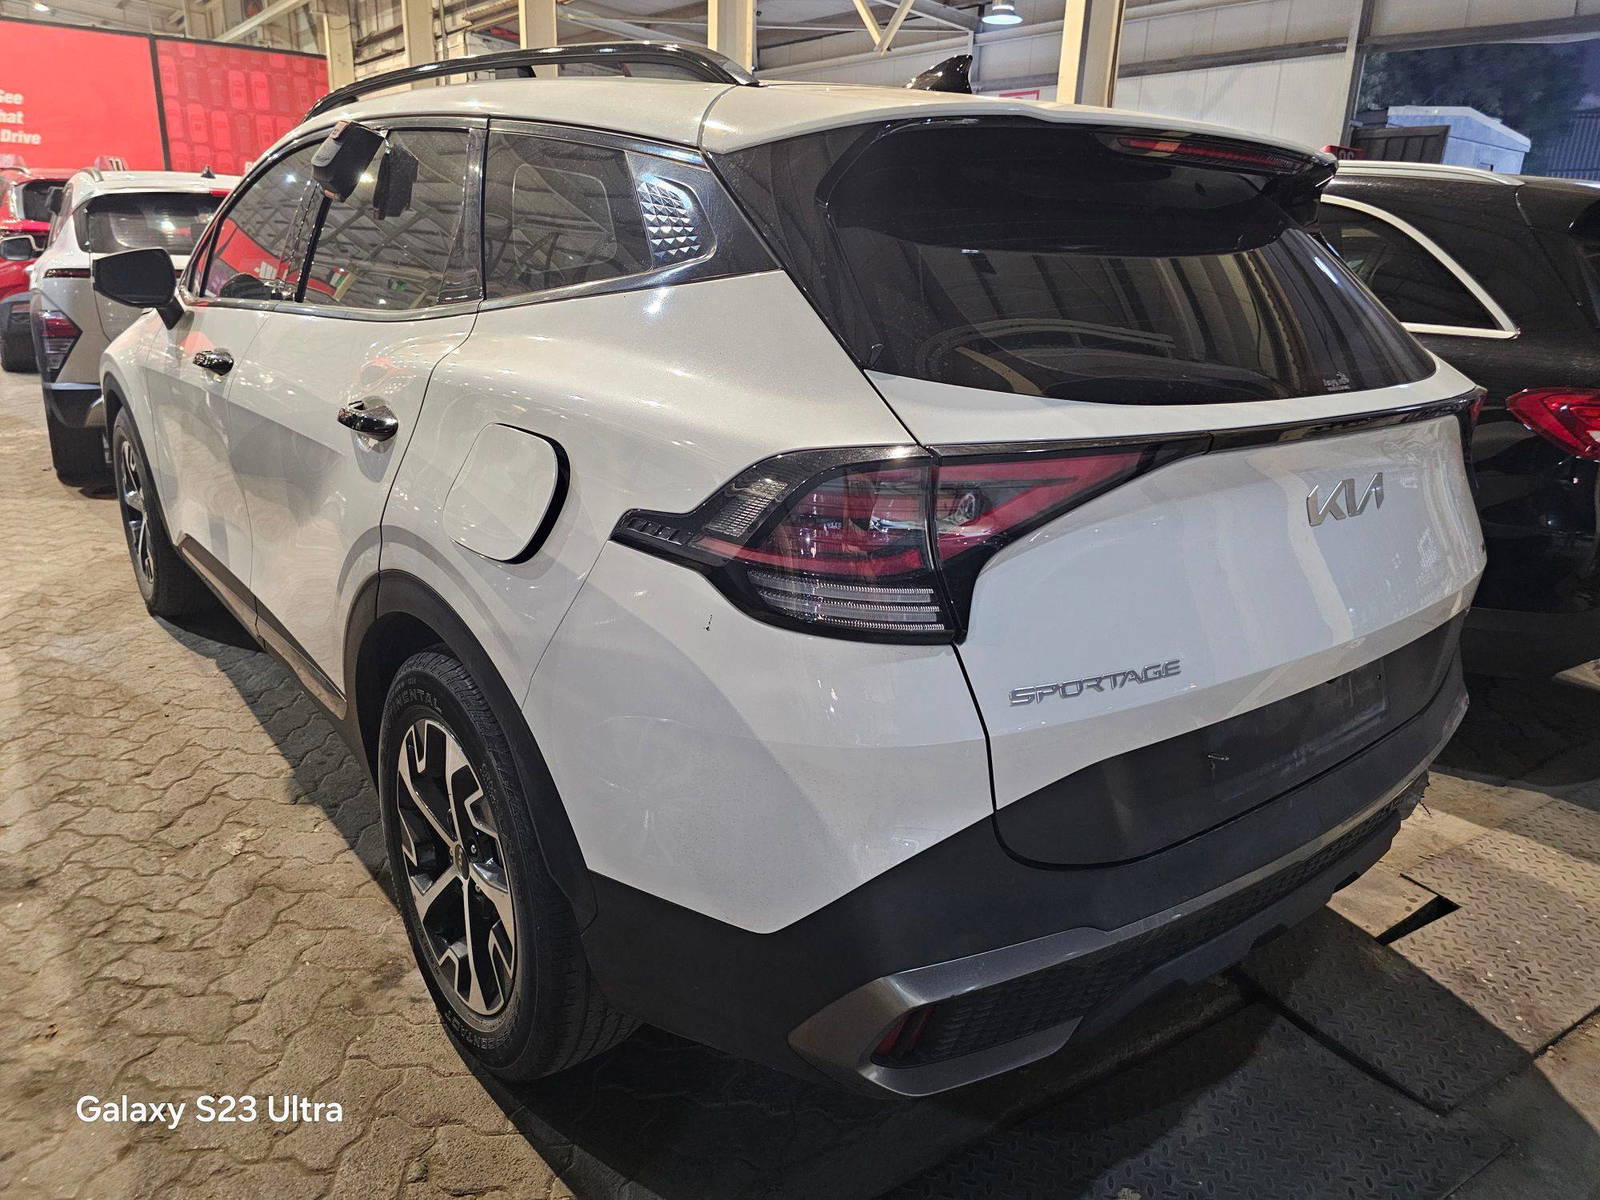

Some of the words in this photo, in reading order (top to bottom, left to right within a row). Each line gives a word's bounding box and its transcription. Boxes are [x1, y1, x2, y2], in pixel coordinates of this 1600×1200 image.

[0, 128, 42, 145] Drive
[1306, 472, 1384, 527] KIA
[1008, 659, 1182, 707] SPORTAGE
